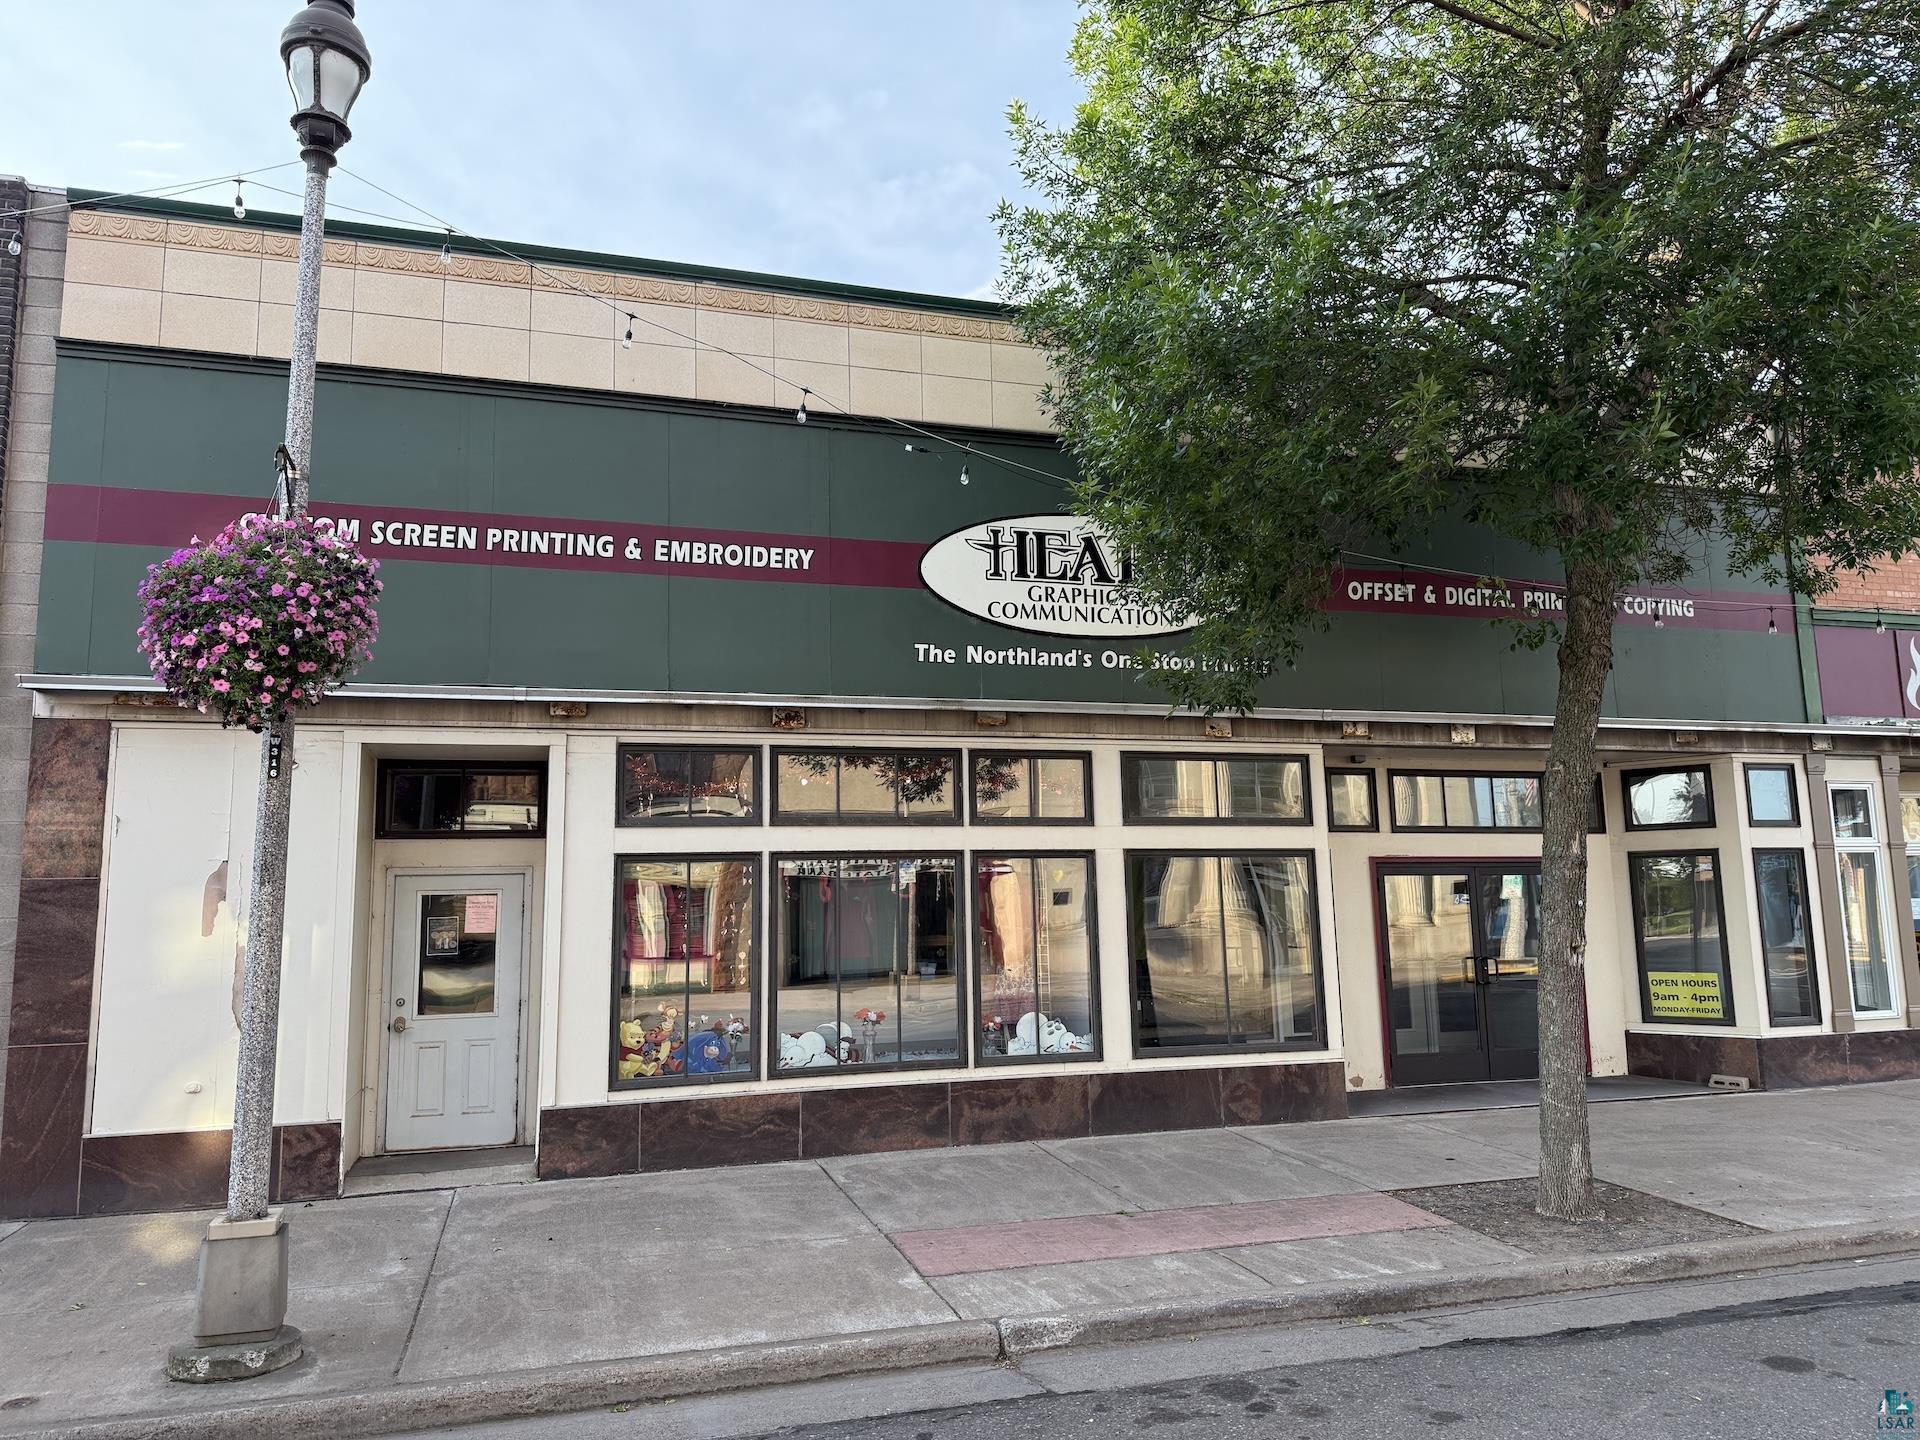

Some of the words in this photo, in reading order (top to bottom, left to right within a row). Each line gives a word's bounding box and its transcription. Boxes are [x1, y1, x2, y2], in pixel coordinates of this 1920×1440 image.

[239, 512, 360, 543] COM
[370, 520, 478, 550] SCREEN
[485, 527, 615, 557] PRINTING
[624, 537, 642, 560] &
[654, 539, 814, 570] EMBROIDERY
[1347, 581, 1416, 603] OFFSET
[1424, 585, 1437, 604] &
[1445, 586, 1516, 608] DIGITAL
[1623, 596, 1695, 617] COPYING
[914, 643, 956, 664] The
[966, 645, 1093, 668] Northland's
[1650, 979, 1678, 987] OPEN
[1681, 980, 1717, 988] HOURS
[1652, 991, 1680, 1001] 9am
[1690, 993, 1719, 1003] 4pm
[1653, 1006, 1721, 1014] MONDAY-FRIDAY
